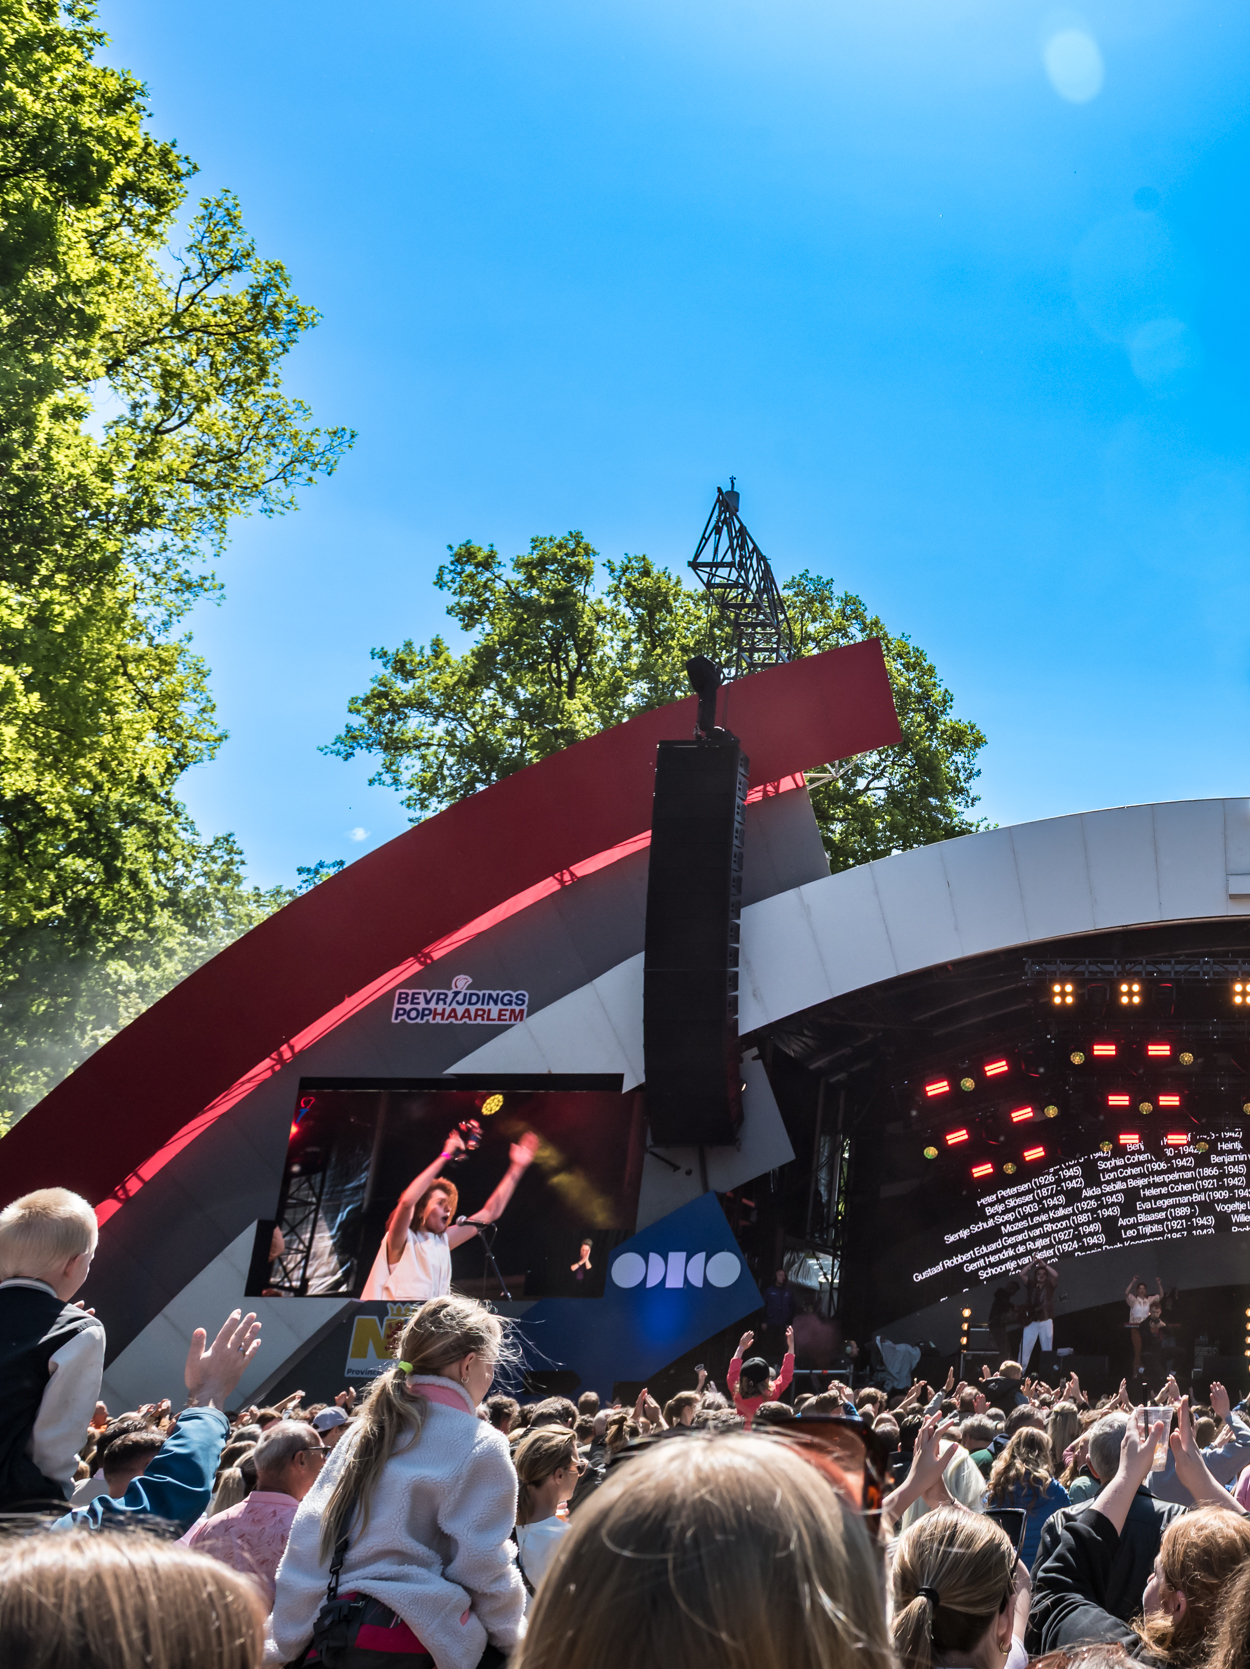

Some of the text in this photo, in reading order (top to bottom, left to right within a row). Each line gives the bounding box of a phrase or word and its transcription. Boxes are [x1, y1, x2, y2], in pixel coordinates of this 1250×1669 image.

[396, 991, 527, 1007] BEVRIJDINGS
[394, 1007, 525, 1022] POPHAARLEM
[1096, 1156, 1124, 1169] Sophia
[1124, 1152, 1151, 1163] Cohen
[1099, 1156, 1194, 1181] Lion Cohen (1906 1942)
[1210, 1152, 1247, 1164] Benjamin
[996, 1182, 1031, 1199] Petersen
[1031, 1173, 1055, 1189] (1926
[1058, 1165, 1081, 1179] 1945)
[1081, 1185, 1101, 1198] Alida
[1101, 1180, 1127, 1193] Sebilla
[1195, 1166, 1219, 1179] (1866
[1223, 1163, 1246, 1175] 1945)
[1139, 1175, 1246, 1197] Helene Cohen (1921 1942)
[984, 1202, 1005, 1215] Betje
[1033, 1184, 1056, 1200] (1877
[1060, 1176, 1084, 1190] 1942)
[1136, 1200, 1151, 1210] Eva
[1151, 1191, 1205, 1208] Legerman-Bril
[1205, 1189, 1228, 1202] (1909
[1214, 1200, 1246, 1213] Vogeltje
[943, 1193, 1065, 1244] Sientje Schuit-Soep (1903 1943)
[1000, 1192, 1124, 1234] Mozes Levie Kalker (1926 1943)
[1117, 1216, 1137, 1226] Aron
[1166, 1205, 1190, 1219] (1889
[1121, 1228, 1137, 1238] Leo
[1163, 1218, 1186, 1232] (1921
[1191, 1214, 1215, 1226] 1943)
[912, 1205, 1120, 1282] Gustaaf Robbert Eduard Gerard van Rhoon (1881 1943)
[963, 1221, 1101, 1272] Gerrit Hendrik de Ruijter (1927 1949)
[977, 1259, 1017, 1279] Schoontje
[1016, 1255, 1032, 1265] van
[1054, 1239, 1078, 1255] (1924
[1082, 1232, 1105, 1246] 1943)
